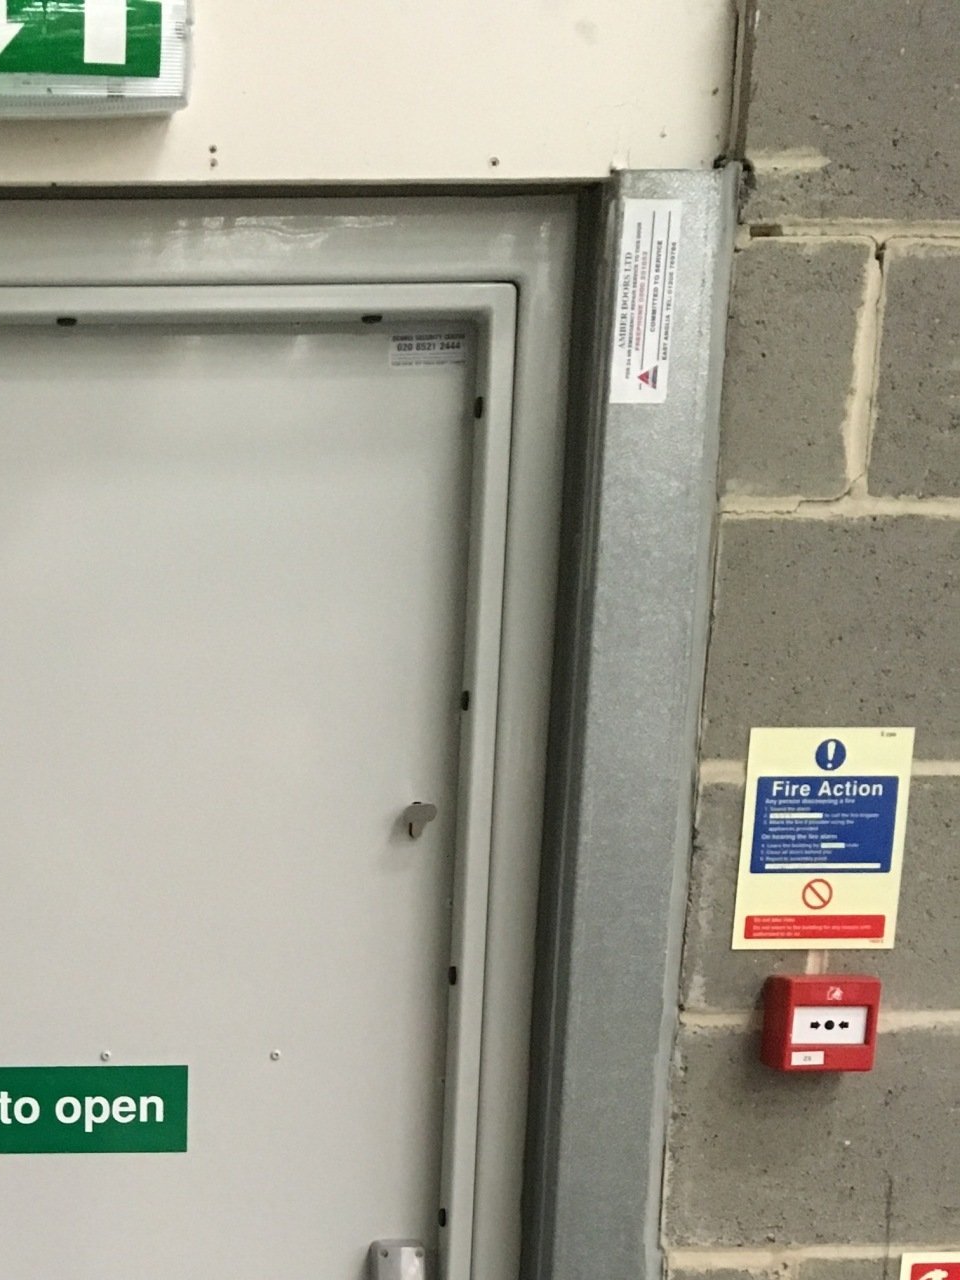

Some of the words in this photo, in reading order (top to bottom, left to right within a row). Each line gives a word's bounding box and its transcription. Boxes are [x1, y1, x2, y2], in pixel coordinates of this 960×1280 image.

[623, 251, 632, 272] LTD
[655, 240, 663, 273] SERVICE
[621, 274, 631, 310] DOORS
[653, 274, 660, 284] TO
[650, 286, 659, 332] COMMITTED
[619, 312, 629, 349] AMBER
[635, 305, 644, 351] FREEPHONE
[416, 342, 436, 351] 8521
[772, 780, 811, 797] Fire
[818, 780, 884, 797] Action
[55, 1093, 165, 1133] open
